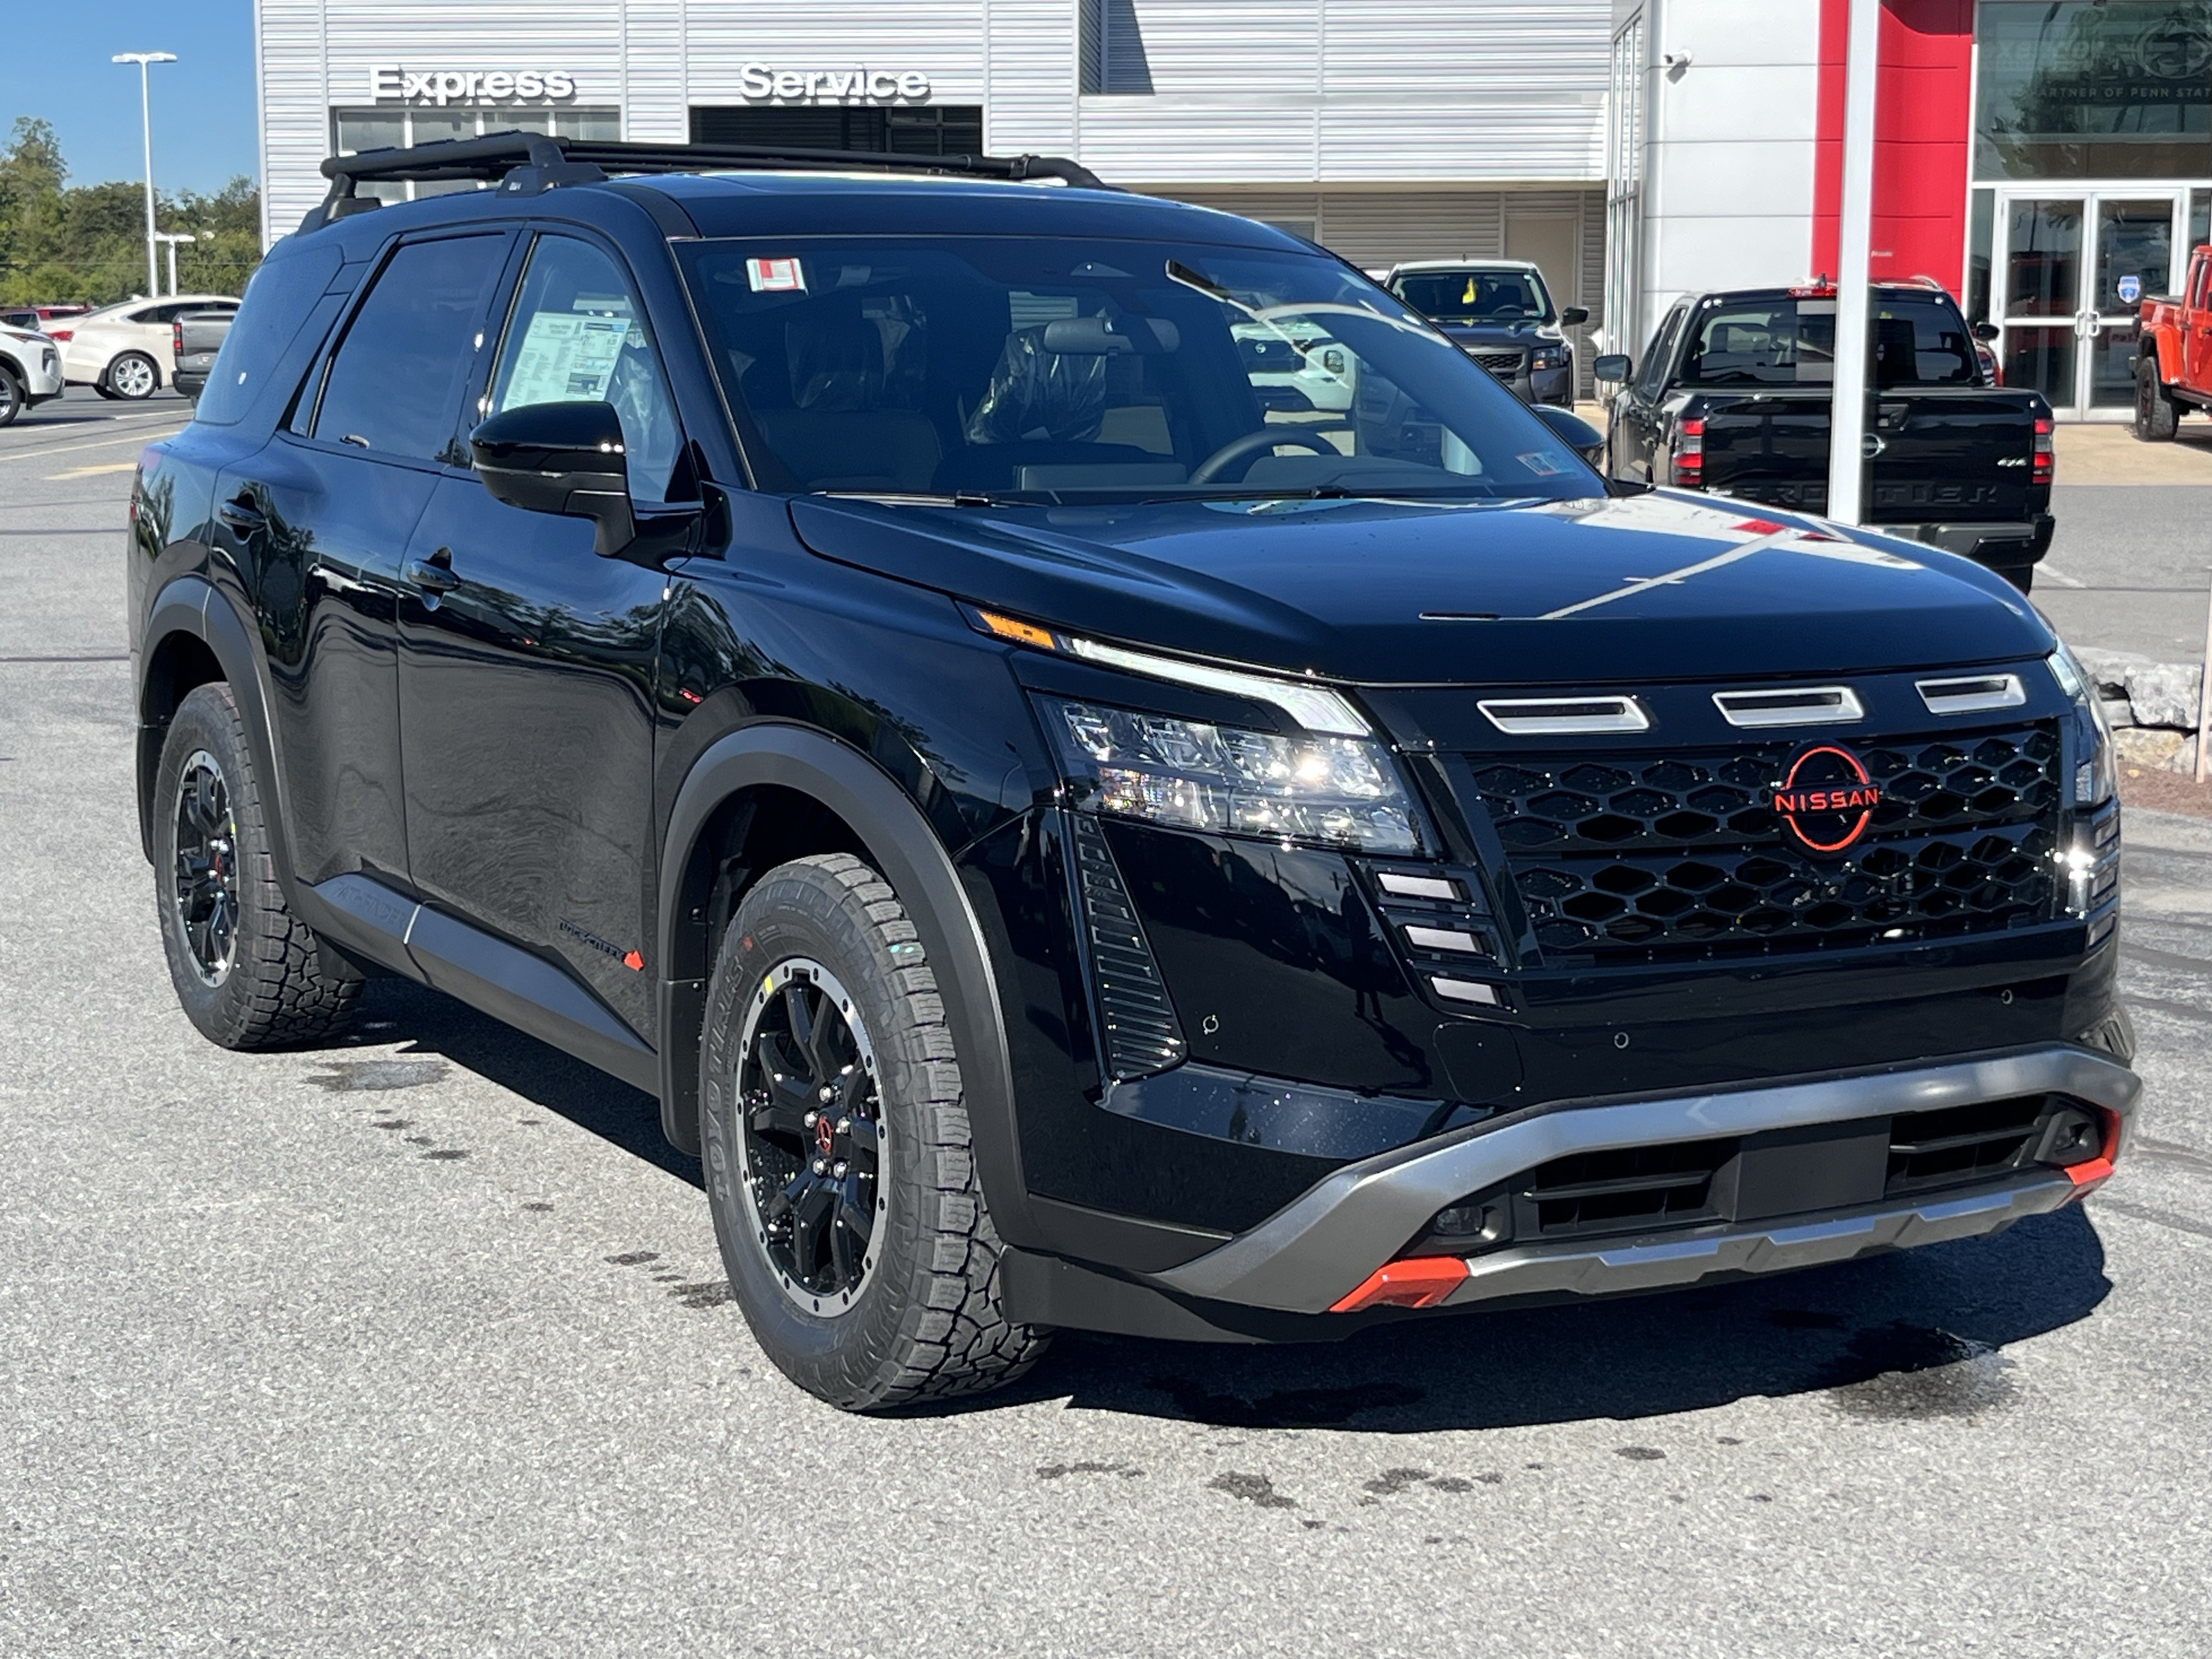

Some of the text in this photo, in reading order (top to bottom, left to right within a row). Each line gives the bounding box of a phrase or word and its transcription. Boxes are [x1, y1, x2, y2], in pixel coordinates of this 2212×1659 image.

[369, 64, 575, 106] Express
[740, 62, 930, 98] Service
[2033, 88, 2097, 97] ARTNER
[2104, 88, 2124, 97] OF
[2130, 88, 2169, 98] PENN
[1741, 486, 1997, 503] FROTIER
[1774, 789, 1877, 812] NISSAN
[708, 955, 744, 1074] TIRES
[707, 1079, 730, 1202] TOYO
